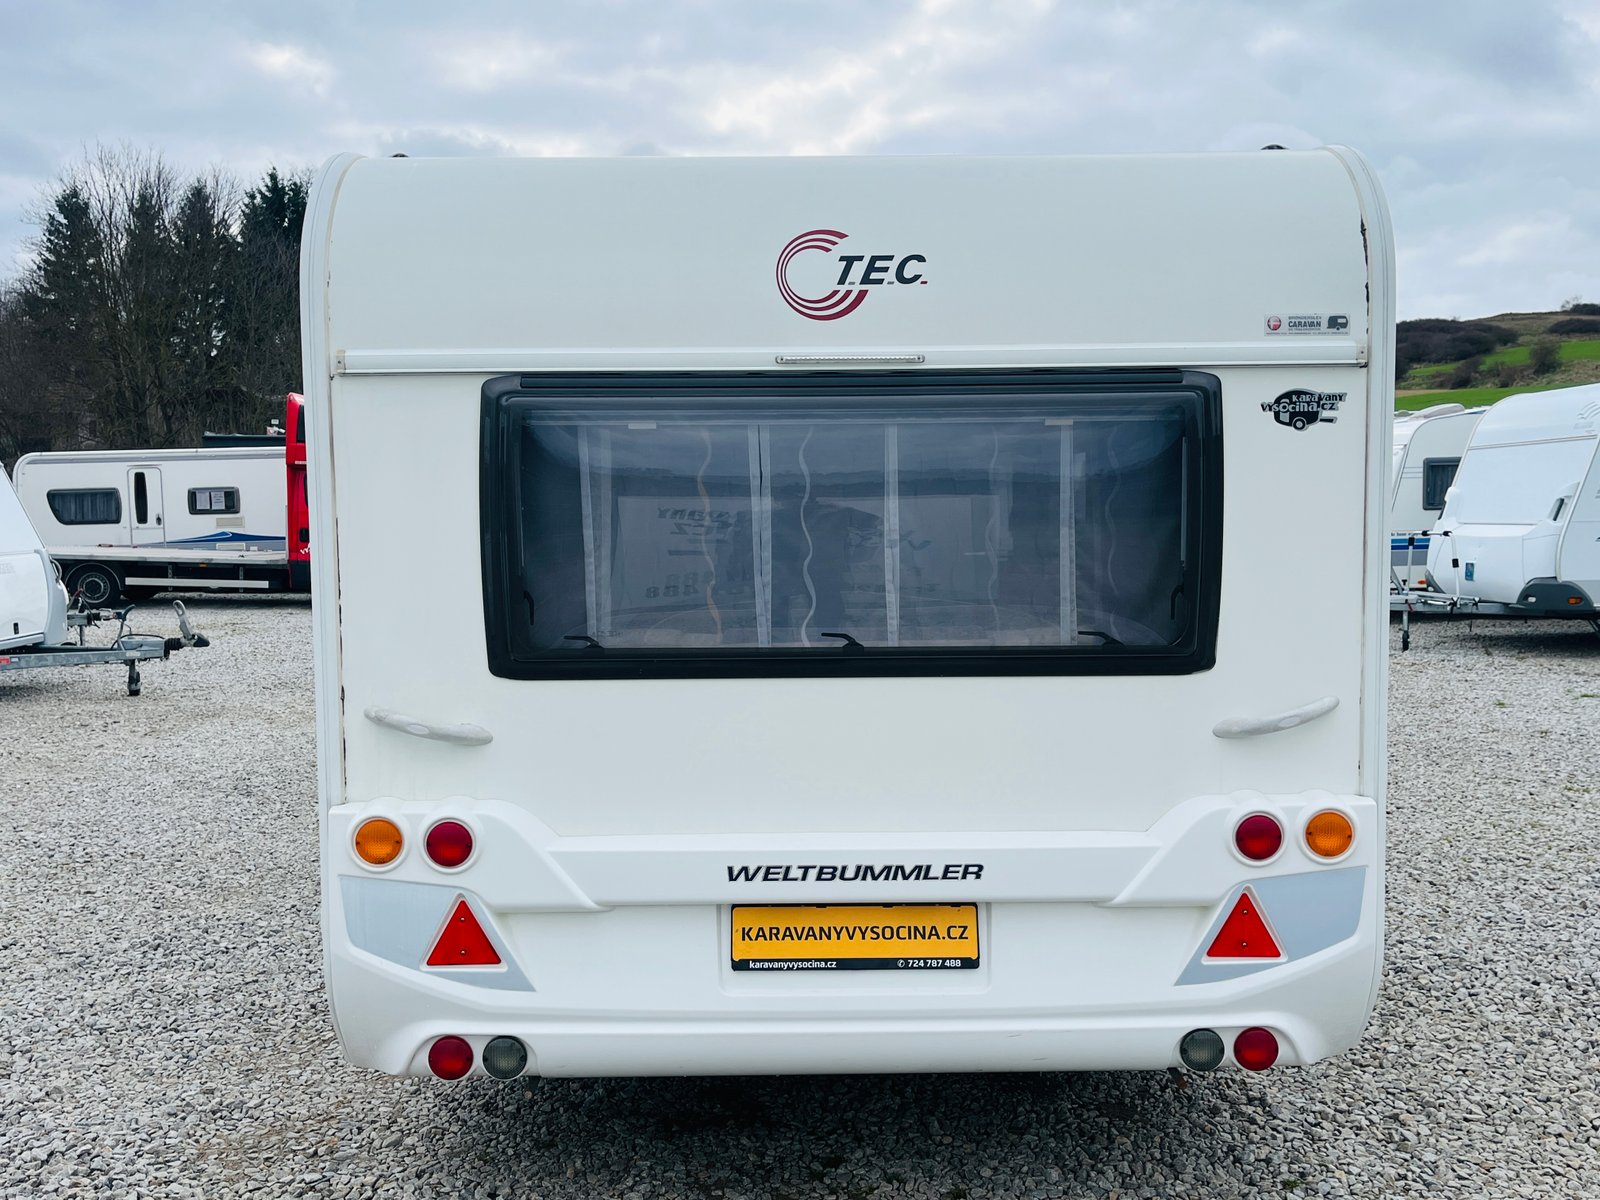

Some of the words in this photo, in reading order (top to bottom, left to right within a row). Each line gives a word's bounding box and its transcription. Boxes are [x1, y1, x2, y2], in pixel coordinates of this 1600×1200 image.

[836, 254, 928, 286] T.E.C.
[1288, 320, 1322, 328] CARAVAN
[727, 864, 985, 882] WELTBUMMLER
[741, 925, 969, 942] KARAVANYVYSOCINA.CZ
[749, 960, 837, 970] karavanyvysocina.cz
[908, 959, 925, 968] 724
[926, 959, 942, 968] 787
[944, 959, 961, 968] 488
